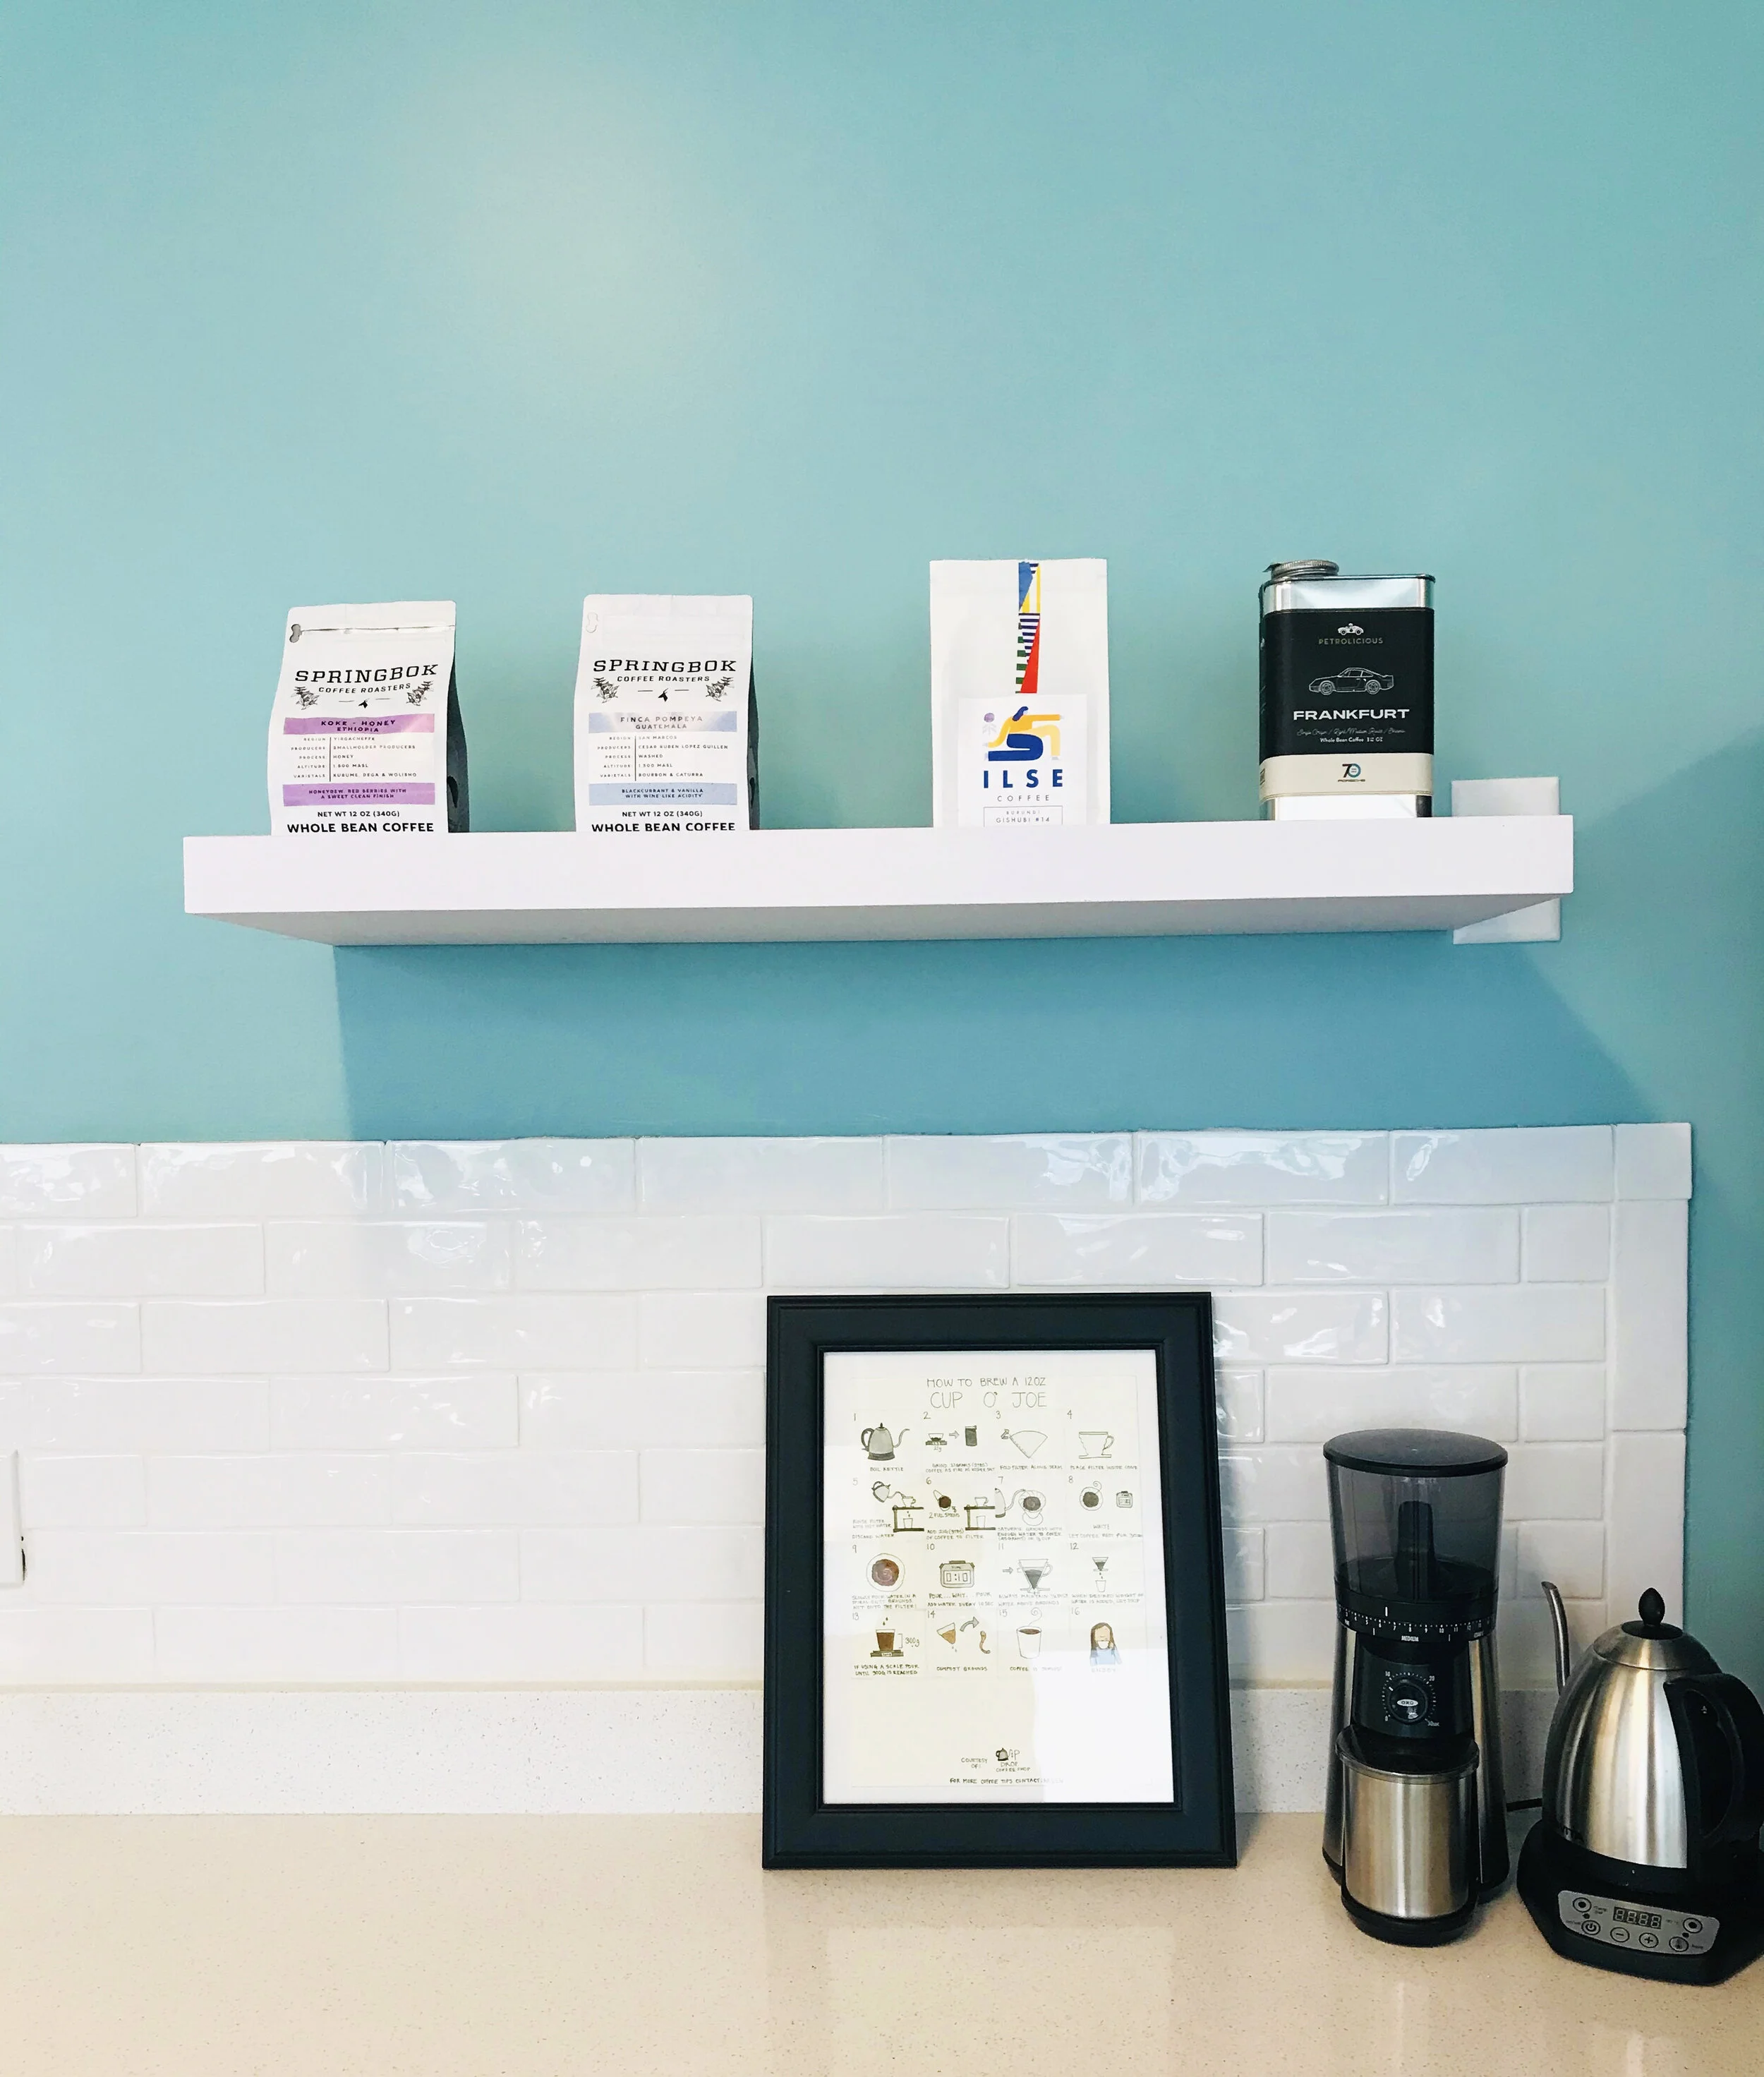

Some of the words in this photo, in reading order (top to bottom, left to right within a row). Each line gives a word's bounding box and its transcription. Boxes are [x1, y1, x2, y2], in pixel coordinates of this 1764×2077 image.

[593, 659, 737, 673] SPRINGBOK
[295, 664, 438, 683] SPRINGBOK
[361, 683, 411, 693] ROASTERS
[1293, 709, 1410, 721] FRANKFURT
[984, 769, 1063, 788] ILSE
[287, 824, 336, 833] WHOLE
[341, 823, 377, 832] BEAN
[382, 822, 434, 832] COFFEE
[591, 824, 640, 832] WHOLE
[645, 823, 680, 831] BEAN
[686, 822, 735, 831] COFFEE
[927, 1378, 953, 1388] HOW
[957, 1378, 972, 1387] TO
[980, 1377, 1007, 1387] BREW
[1012, 1377, 1018, 1386] A
[1025, 1377, 1046, 1386] 12OZ
[930, 1391, 962, 1409] CUP
[1011, 1391, 1047, 1408] JOE
[854, 1413, 857, 1421] 1
[923, 1411, 931, 1419] 2
[996, 1410, 1001, 1419] 3
[1067, 1409, 1073, 1419] 4
[852, 1477, 858, 1486] 5
[926, 1476, 932, 1485] 6
[998, 1476, 1004, 1484] 7
[1068, 1475, 1073, 1483] 8
[852, 1544, 857, 1553] 9
[998, 1542, 1004, 1551] 11
[1070, 1542, 1079, 1551] 12
[927, 1610, 936, 1619] 14
[999, 1608, 1008, 1618] 15
[1071, 1607, 1080, 1615] 16
[852, 1612, 859, 1621] 13
[905, 1637, 920, 1647] 300g
